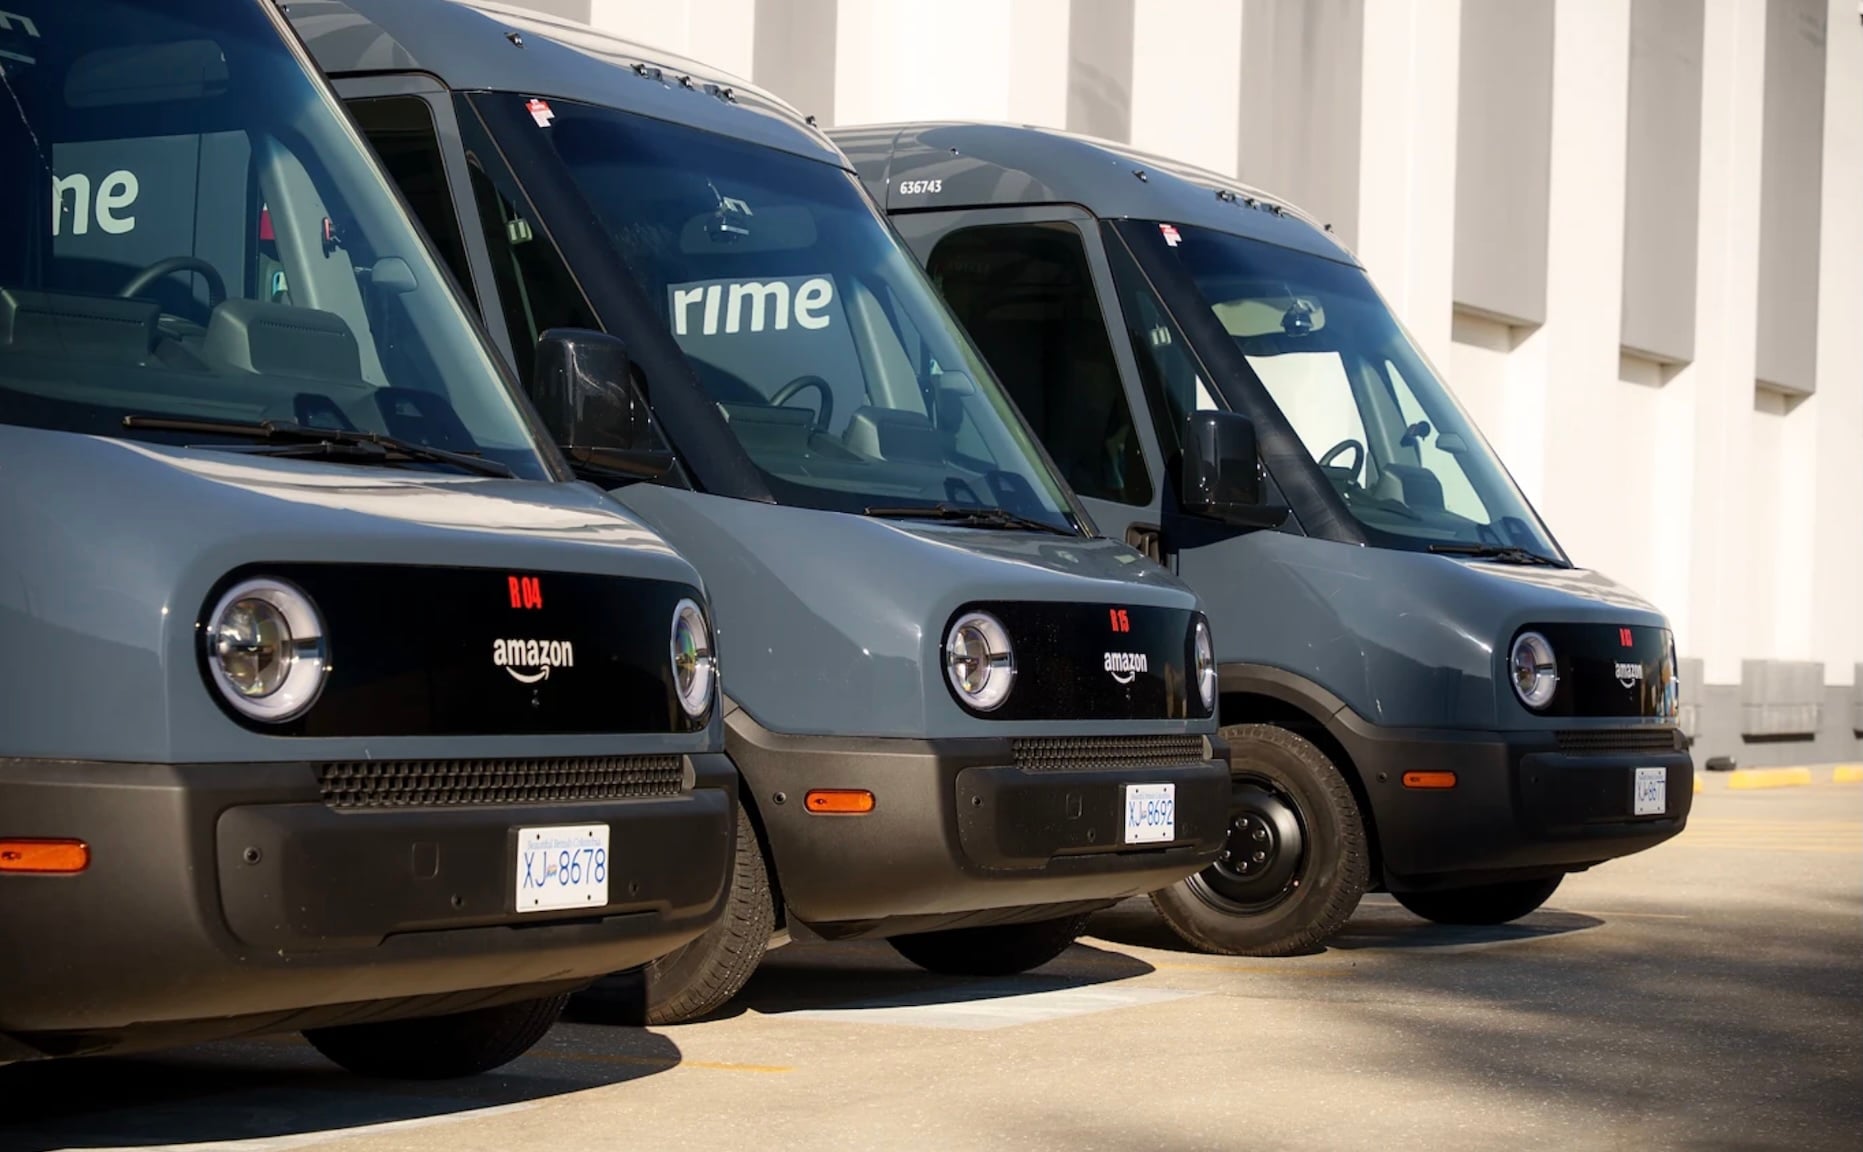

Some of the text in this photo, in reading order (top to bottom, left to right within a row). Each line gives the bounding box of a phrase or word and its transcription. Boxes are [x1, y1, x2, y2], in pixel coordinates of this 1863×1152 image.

[900, 179, 942, 195] 636743
[493, 638, 574, 668] amazon
[1103, 652, 1148, 673] amazon
